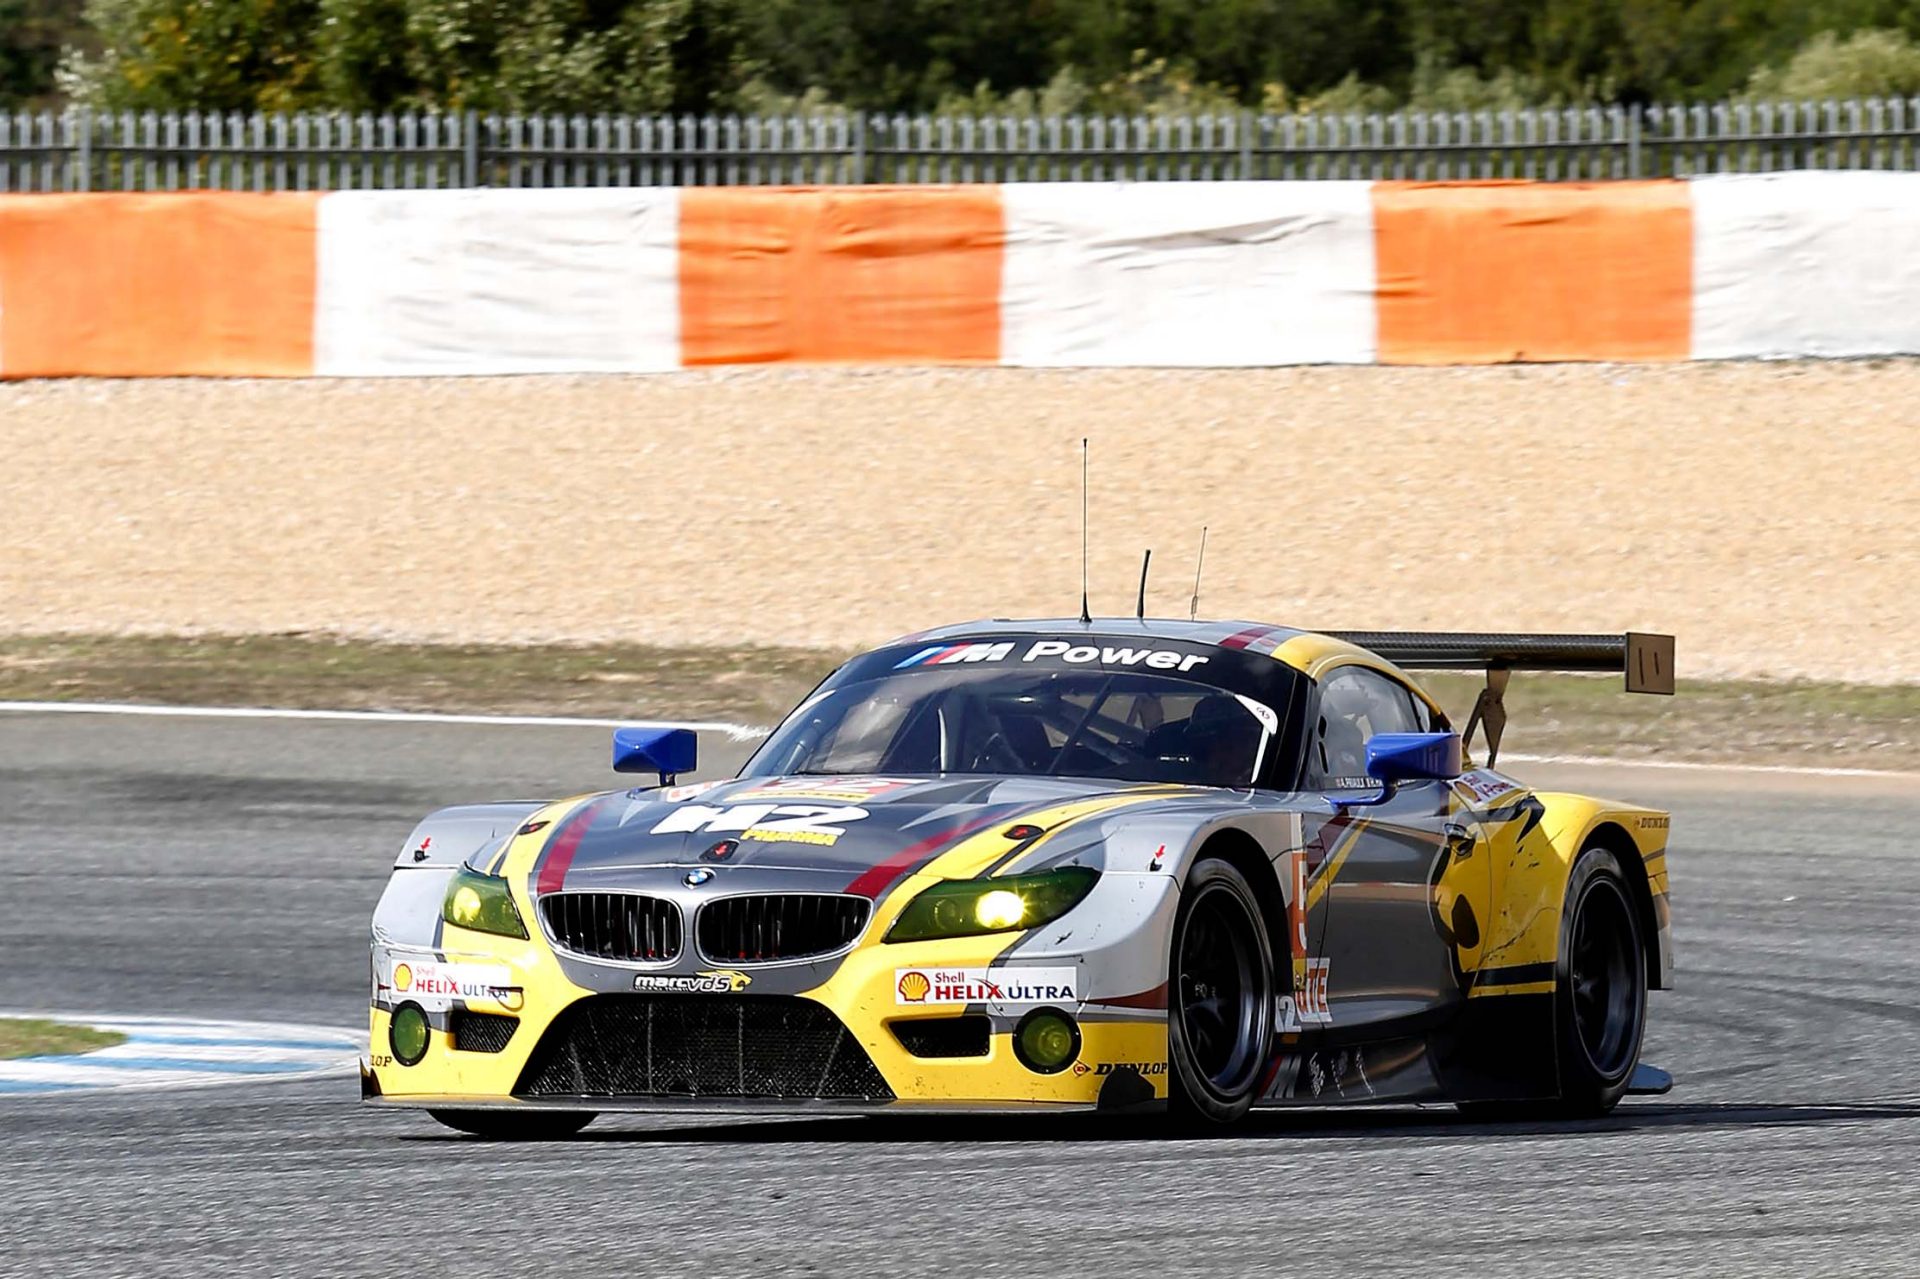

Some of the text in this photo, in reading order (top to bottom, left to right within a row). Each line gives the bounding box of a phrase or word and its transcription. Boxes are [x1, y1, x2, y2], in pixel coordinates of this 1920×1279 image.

[1022, 641, 1210, 672] Power
[649, 803, 870, 835] H2
[415, 978, 460, 995] HELIX
[935, 972, 965, 984] Shell
[935, 985, 1075, 1001] HELIX ULTRA
